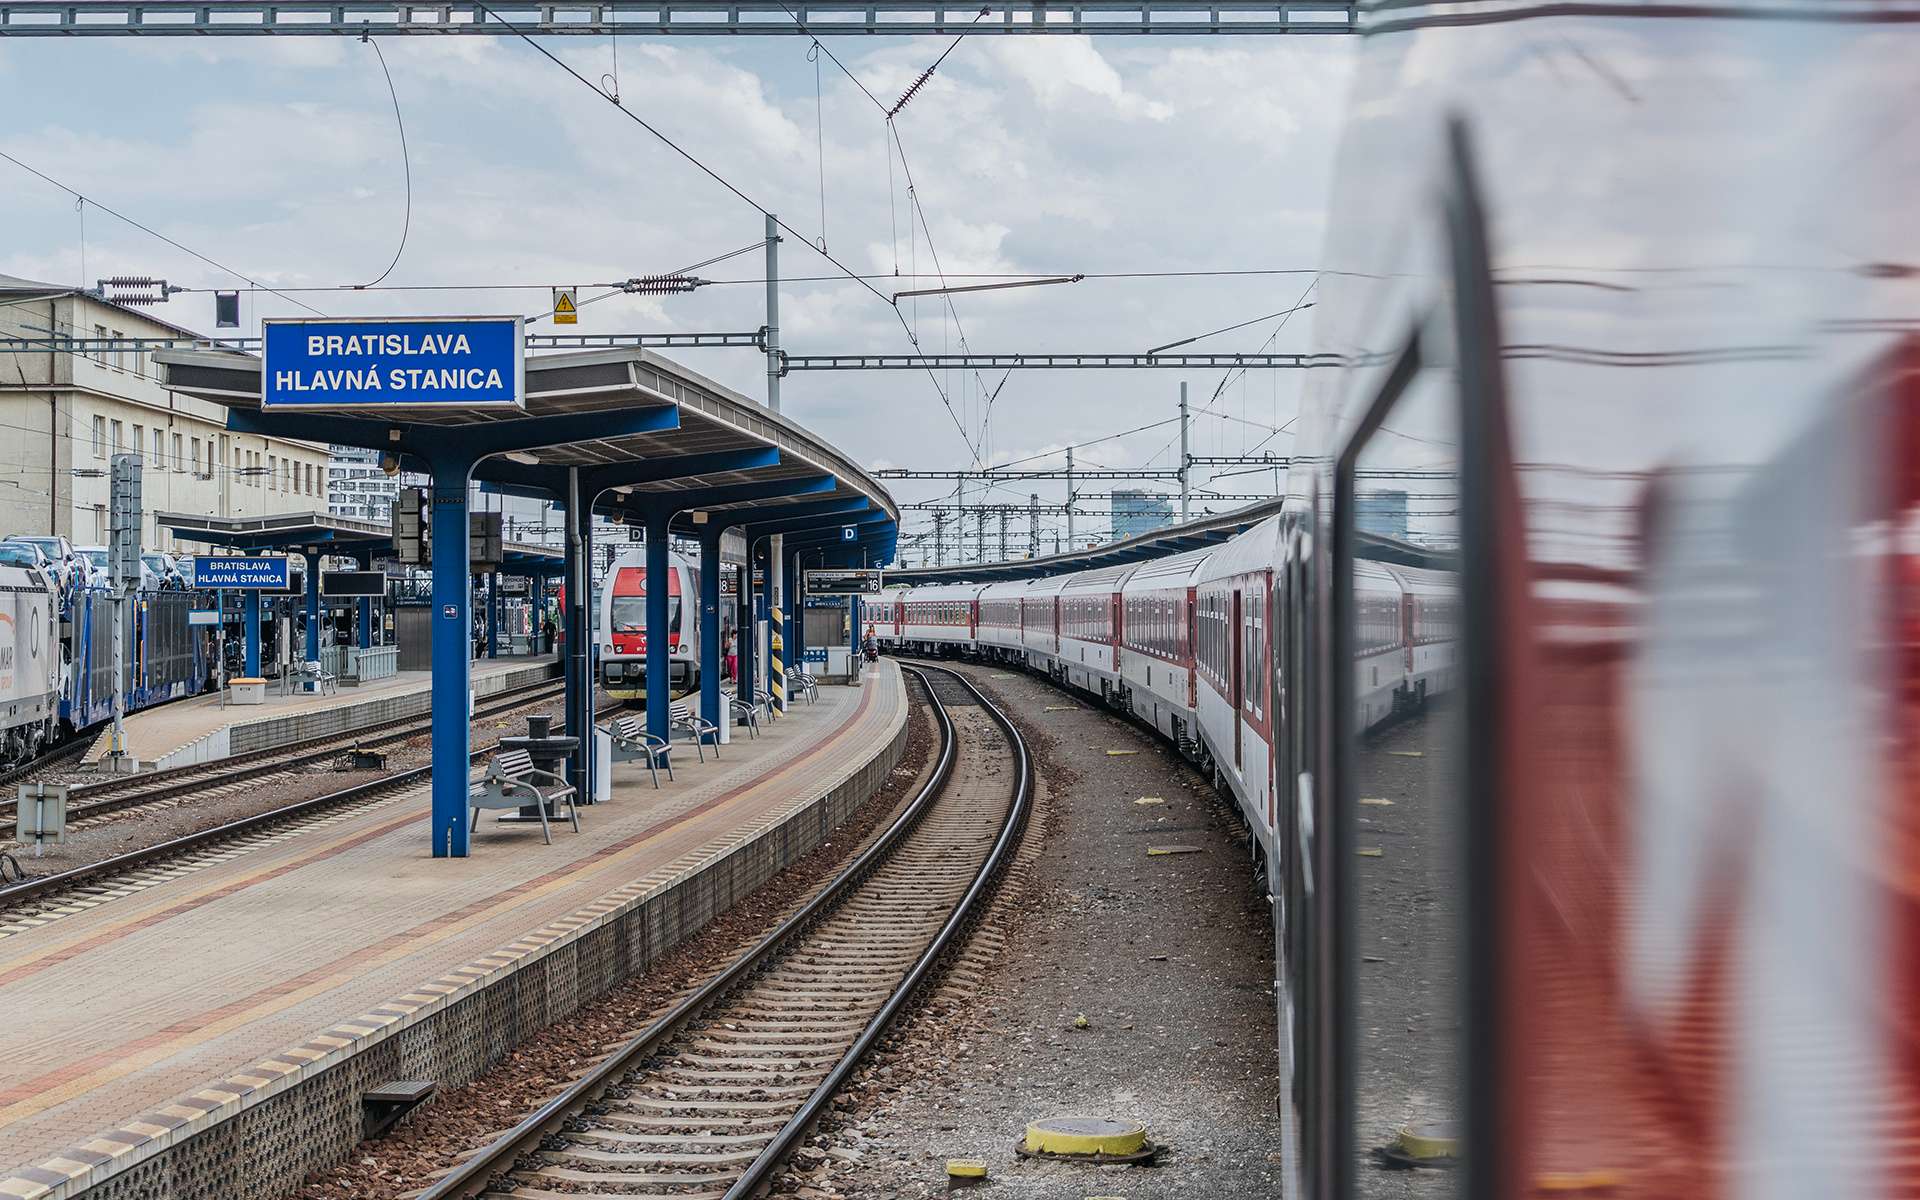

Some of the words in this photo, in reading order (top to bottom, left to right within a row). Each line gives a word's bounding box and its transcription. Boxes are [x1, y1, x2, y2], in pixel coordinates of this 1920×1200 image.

[308, 334, 471, 356] BRATISLAVA
[276, 364, 382, 391] HLAVNÁ
[390, 369, 503, 390] STANICA
[632, 529, 641, 540] D
[845, 528, 855, 540] D
[210, 562, 271, 571] BRATISLAVA
[198, 573, 237, 583] HLAVNÁ
[240, 575, 283, 583] STANICA
[868, 579, 879, 591] 16
